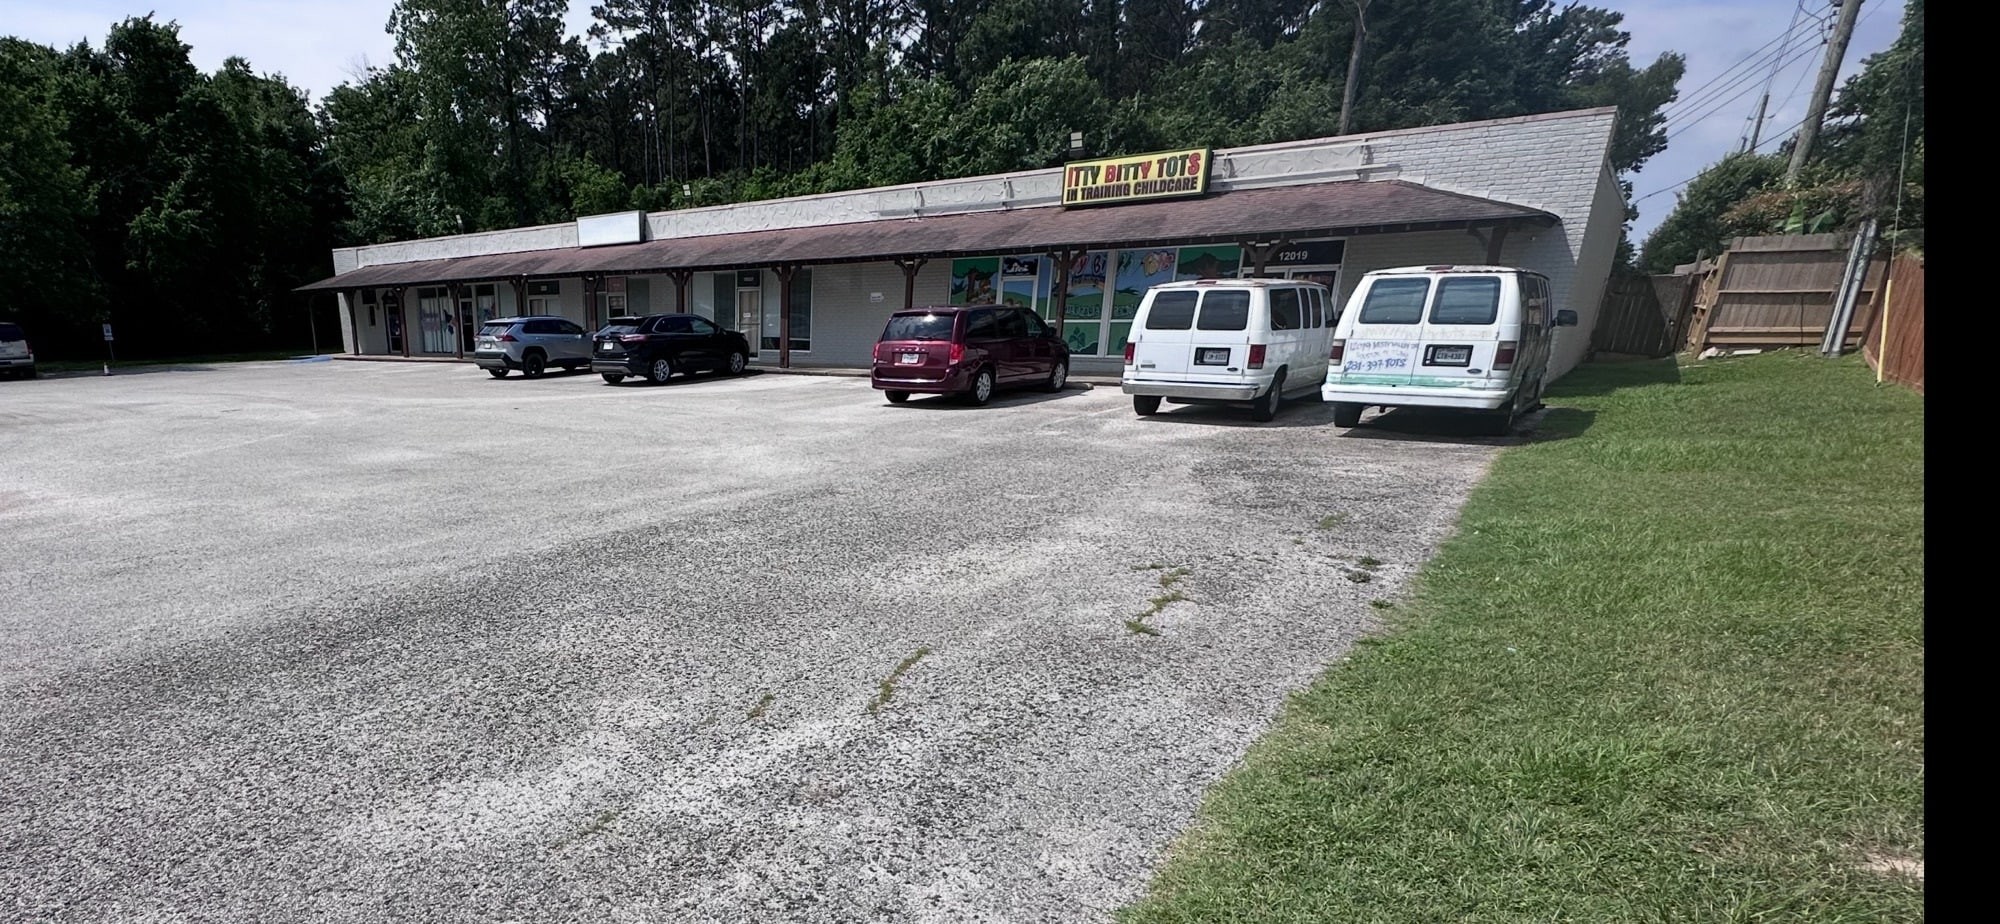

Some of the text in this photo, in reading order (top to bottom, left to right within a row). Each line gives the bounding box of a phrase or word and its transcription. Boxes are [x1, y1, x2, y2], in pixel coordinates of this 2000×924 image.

[1067, 152, 1201, 188] ITTY BITTY TOTS
[1066, 176, 1198, 201] IN TRAINING CHILDCARE
[1278, 250, 1309, 261] 12019
